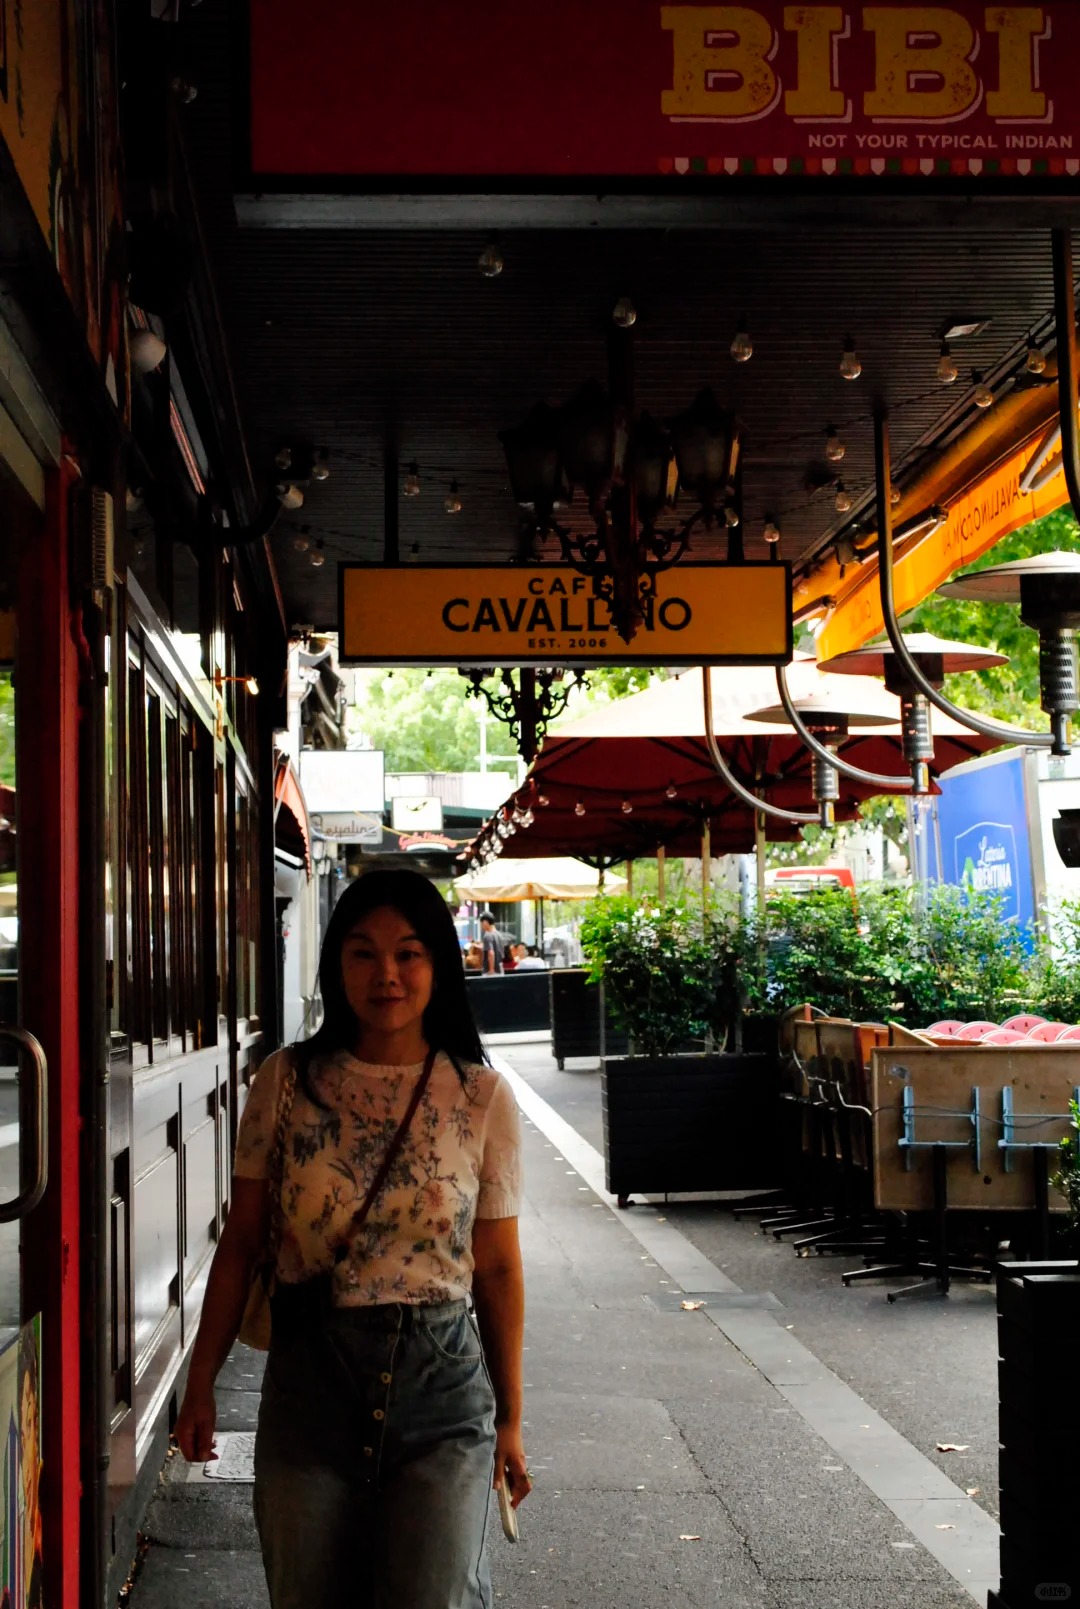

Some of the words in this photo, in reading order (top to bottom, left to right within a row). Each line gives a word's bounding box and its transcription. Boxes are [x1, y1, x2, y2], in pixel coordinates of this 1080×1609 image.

[660, 6, 1054, 124] BIBI
[808, 134, 847, 148] NOT
[855, 134, 908, 148] YOUR
[916, 134, 998, 148] TYPICAL
[1005, 134, 1073, 148] INDIAN
[528, 577, 604, 595] CAF
[442, 597, 693, 632] CAVALLNO
[528, 638, 561, 648] EST.
[569, 638, 607, 648] 2006
